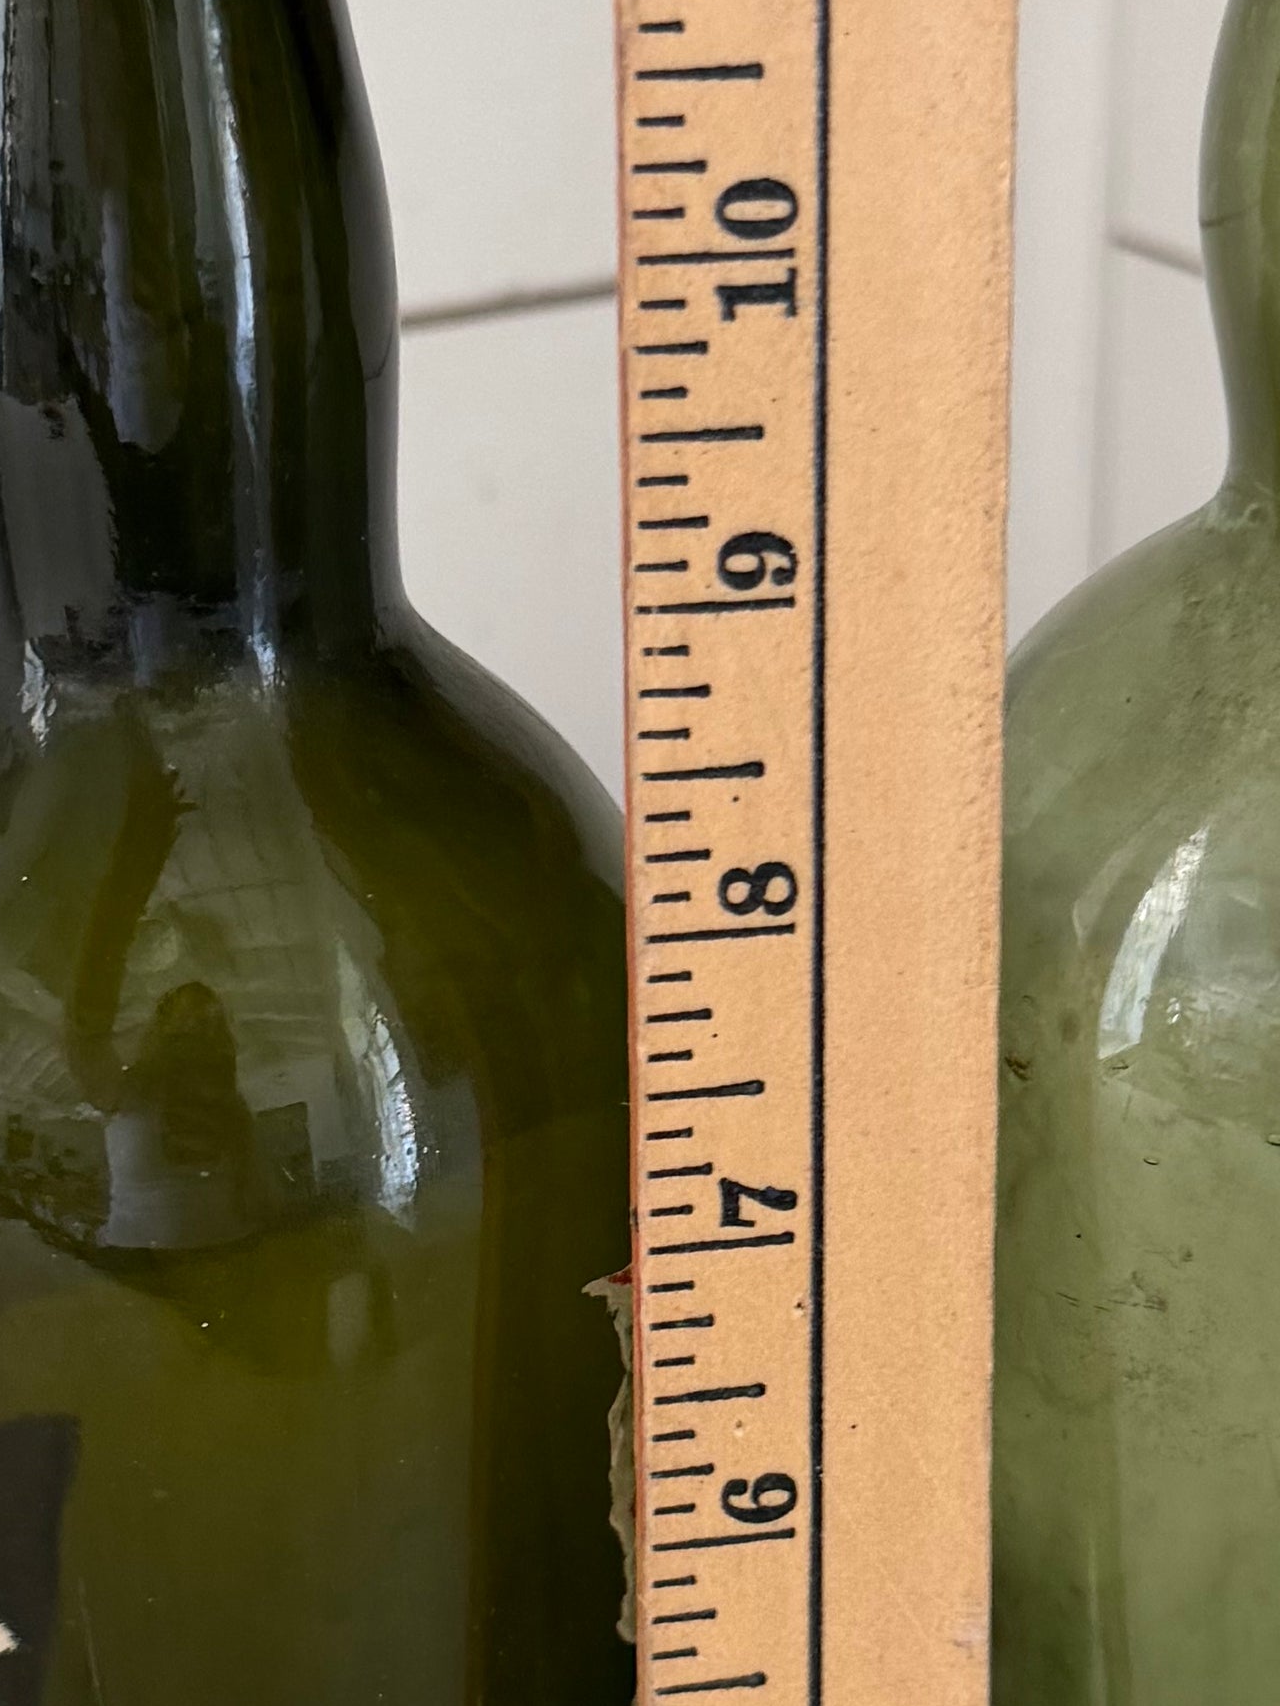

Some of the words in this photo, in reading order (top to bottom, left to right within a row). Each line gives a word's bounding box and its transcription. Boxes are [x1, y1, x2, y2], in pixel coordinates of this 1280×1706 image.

[714, 177, 800, 322] 10
[717, 530, 800, 592] 9
[719, 860, 800, 917] 8
[718, 1177, 799, 1228] 7
[720, 1471, 799, 1525] 6
